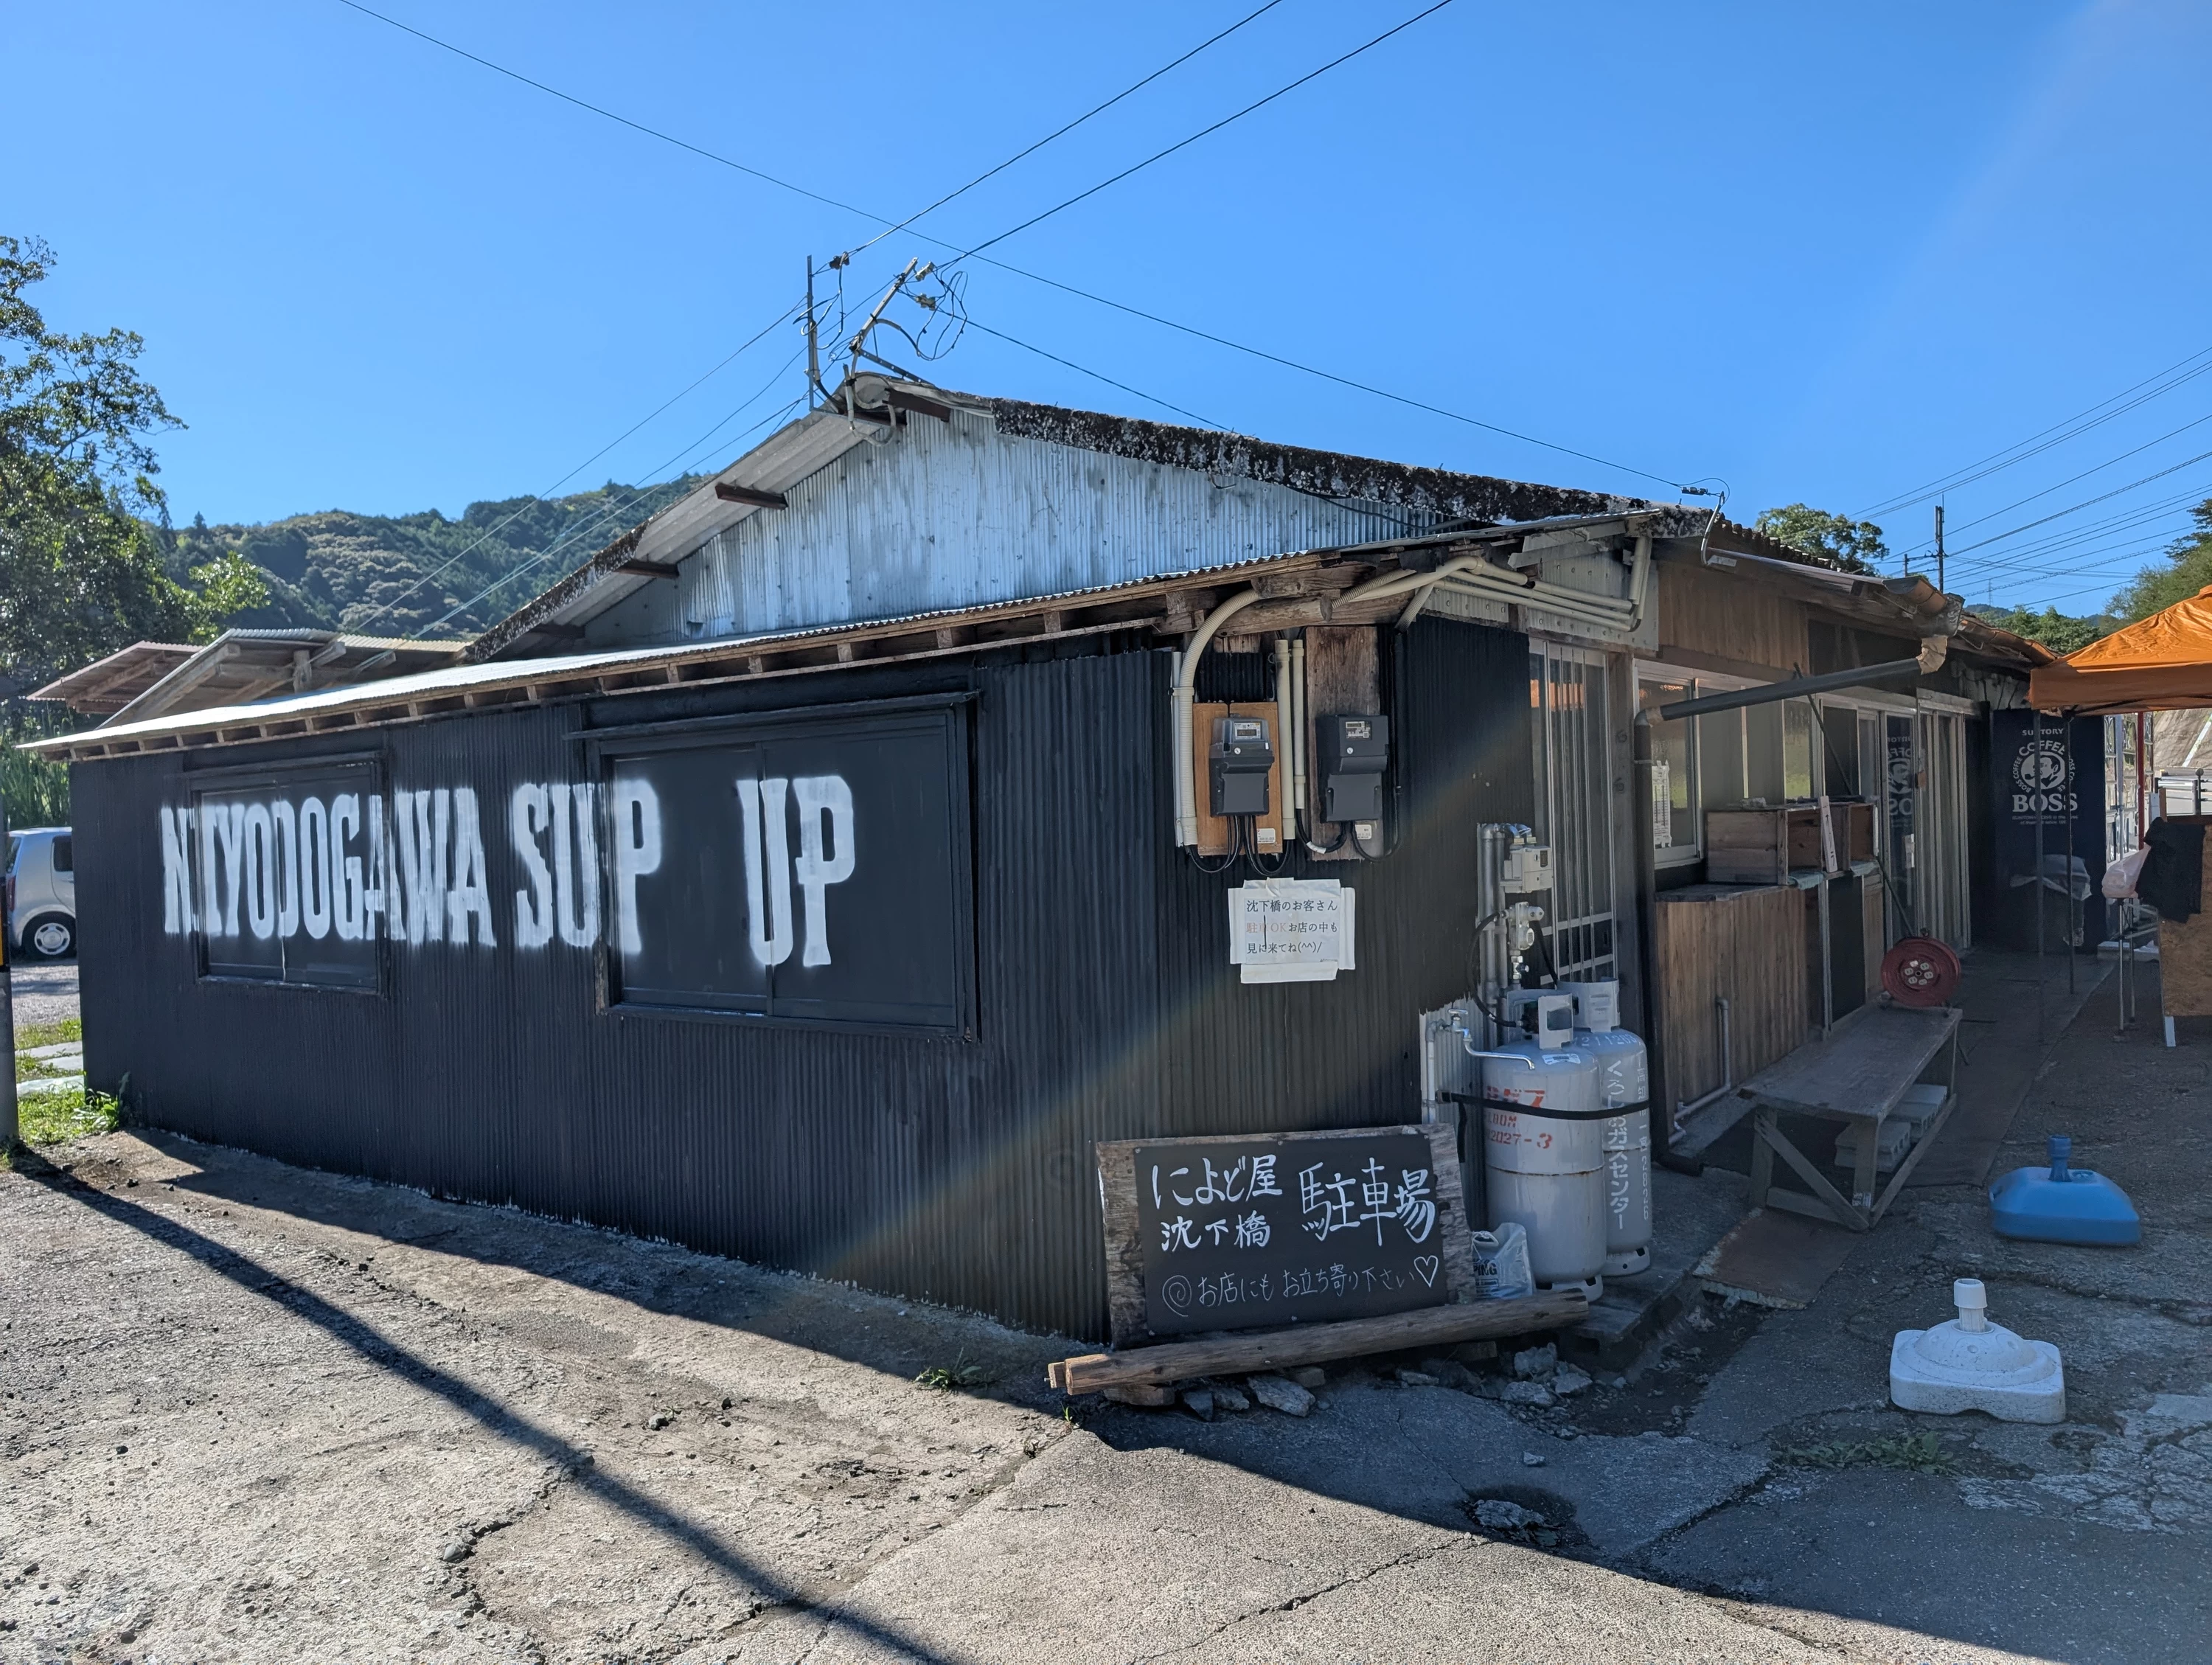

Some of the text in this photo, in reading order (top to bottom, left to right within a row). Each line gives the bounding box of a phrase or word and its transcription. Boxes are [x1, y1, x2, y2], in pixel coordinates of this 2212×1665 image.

[2022, 728, 2064, 736] SUTORY
[2013, 756, 2031, 793] BOSS COFFEE
[2012, 793, 2078, 812] BOSS
[161, 775, 855, 966] NIYODOGAWA SUP UP
[1247, 900, 1338, 912] 沈下橋のお客さん
[1152, 1154, 1436, 1245] によど屋 駐車場
[1161, 1210, 1270, 1252] 沈下橋
[1198, 1262, 1416, 1306] お店にも お立ち寄り下さい
